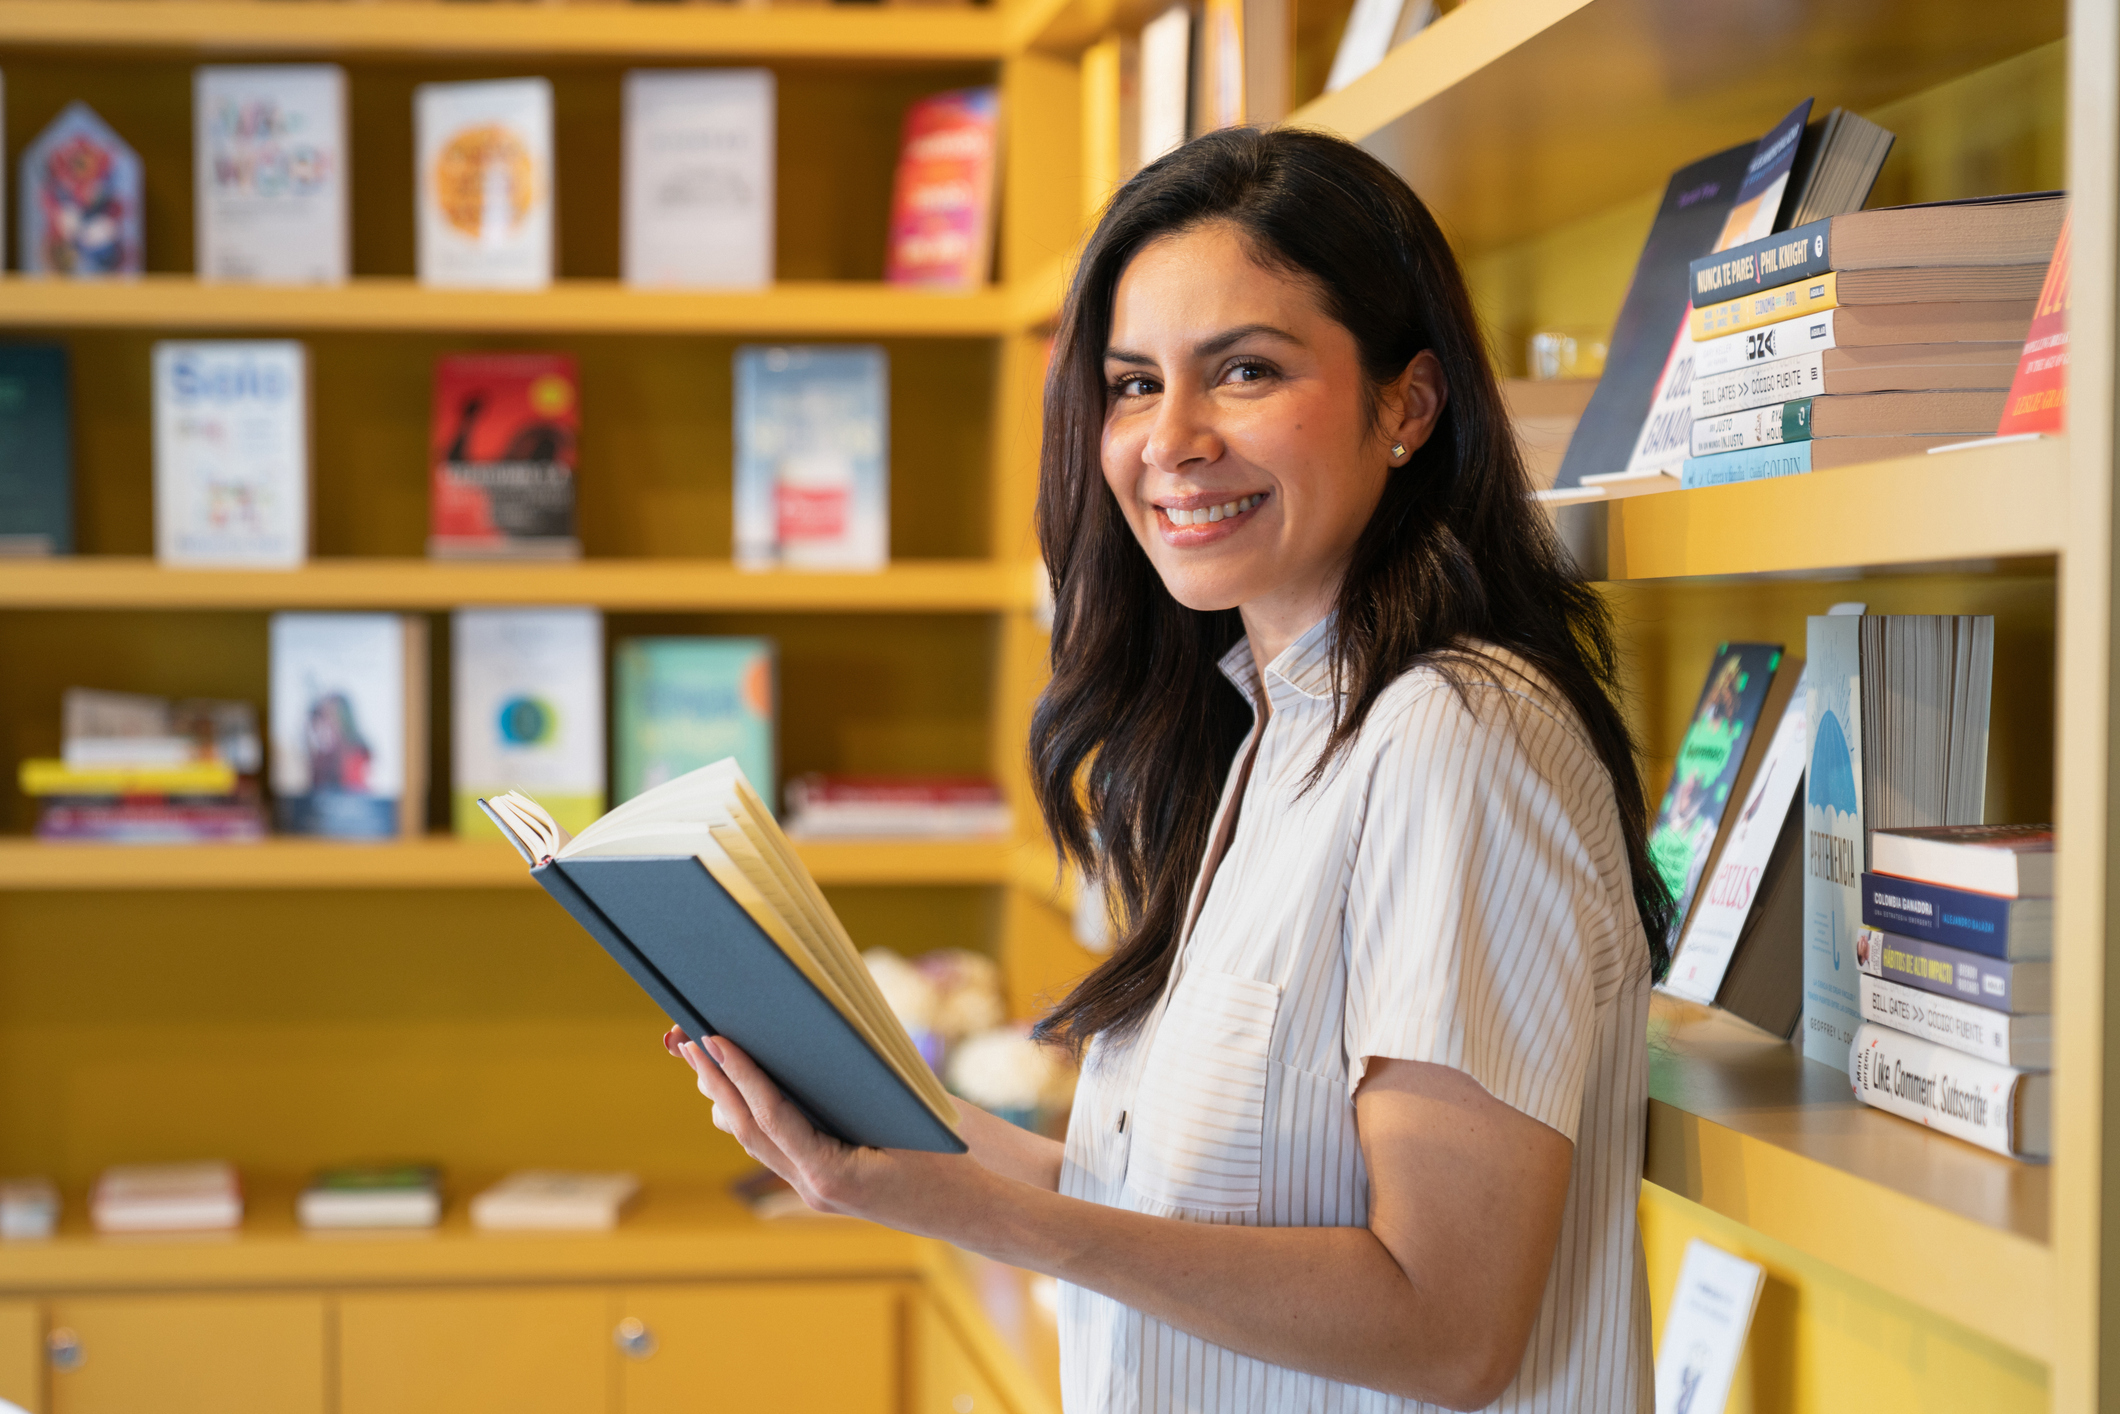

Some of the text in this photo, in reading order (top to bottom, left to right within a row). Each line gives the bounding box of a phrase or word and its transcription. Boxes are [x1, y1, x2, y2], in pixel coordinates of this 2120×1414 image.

[1697, 239, 1808, 293] NUNCA TE PARES PHIL KNIGHT
[1703, 385, 1716, 405] BILL
[1718, 384, 1736, 402] GATES
[1777, 369, 1801, 390] FUENTE
[1716, 418, 1733, 433] JUSTO
[1709, 439, 1721, 449] MUNDO
[1720, 433, 1744, 448] INJUSTO
[1763, 457, 1801, 479] GOLDIN
[1810, 829, 1855, 888] PERTENENCIA
[1874, 891, 1933, 916] COLOMBIA GANADORA
[1943, 913, 1971, 929] ALEJANDRO
[1883, 945, 1906, 973] HÁBITOS
[1906, 954, 1914, 974] DE
[1914, 956, 1928, 978] ALTO
[1928, 959, 1953, 985] IMPACTO
[1810, 1017, 1836, 1038] GEOFFREY
[1872, 992, 1887, 1012] BILL
[1889, 998, 1910, 1020] GATES
[1928, 1004, 1954, 1033] CÓDIGO
[1956, 1019, 1984, 1043] FUENTE
[1873, 1052, 1988, 1127] Like, Comment, Subscribe
